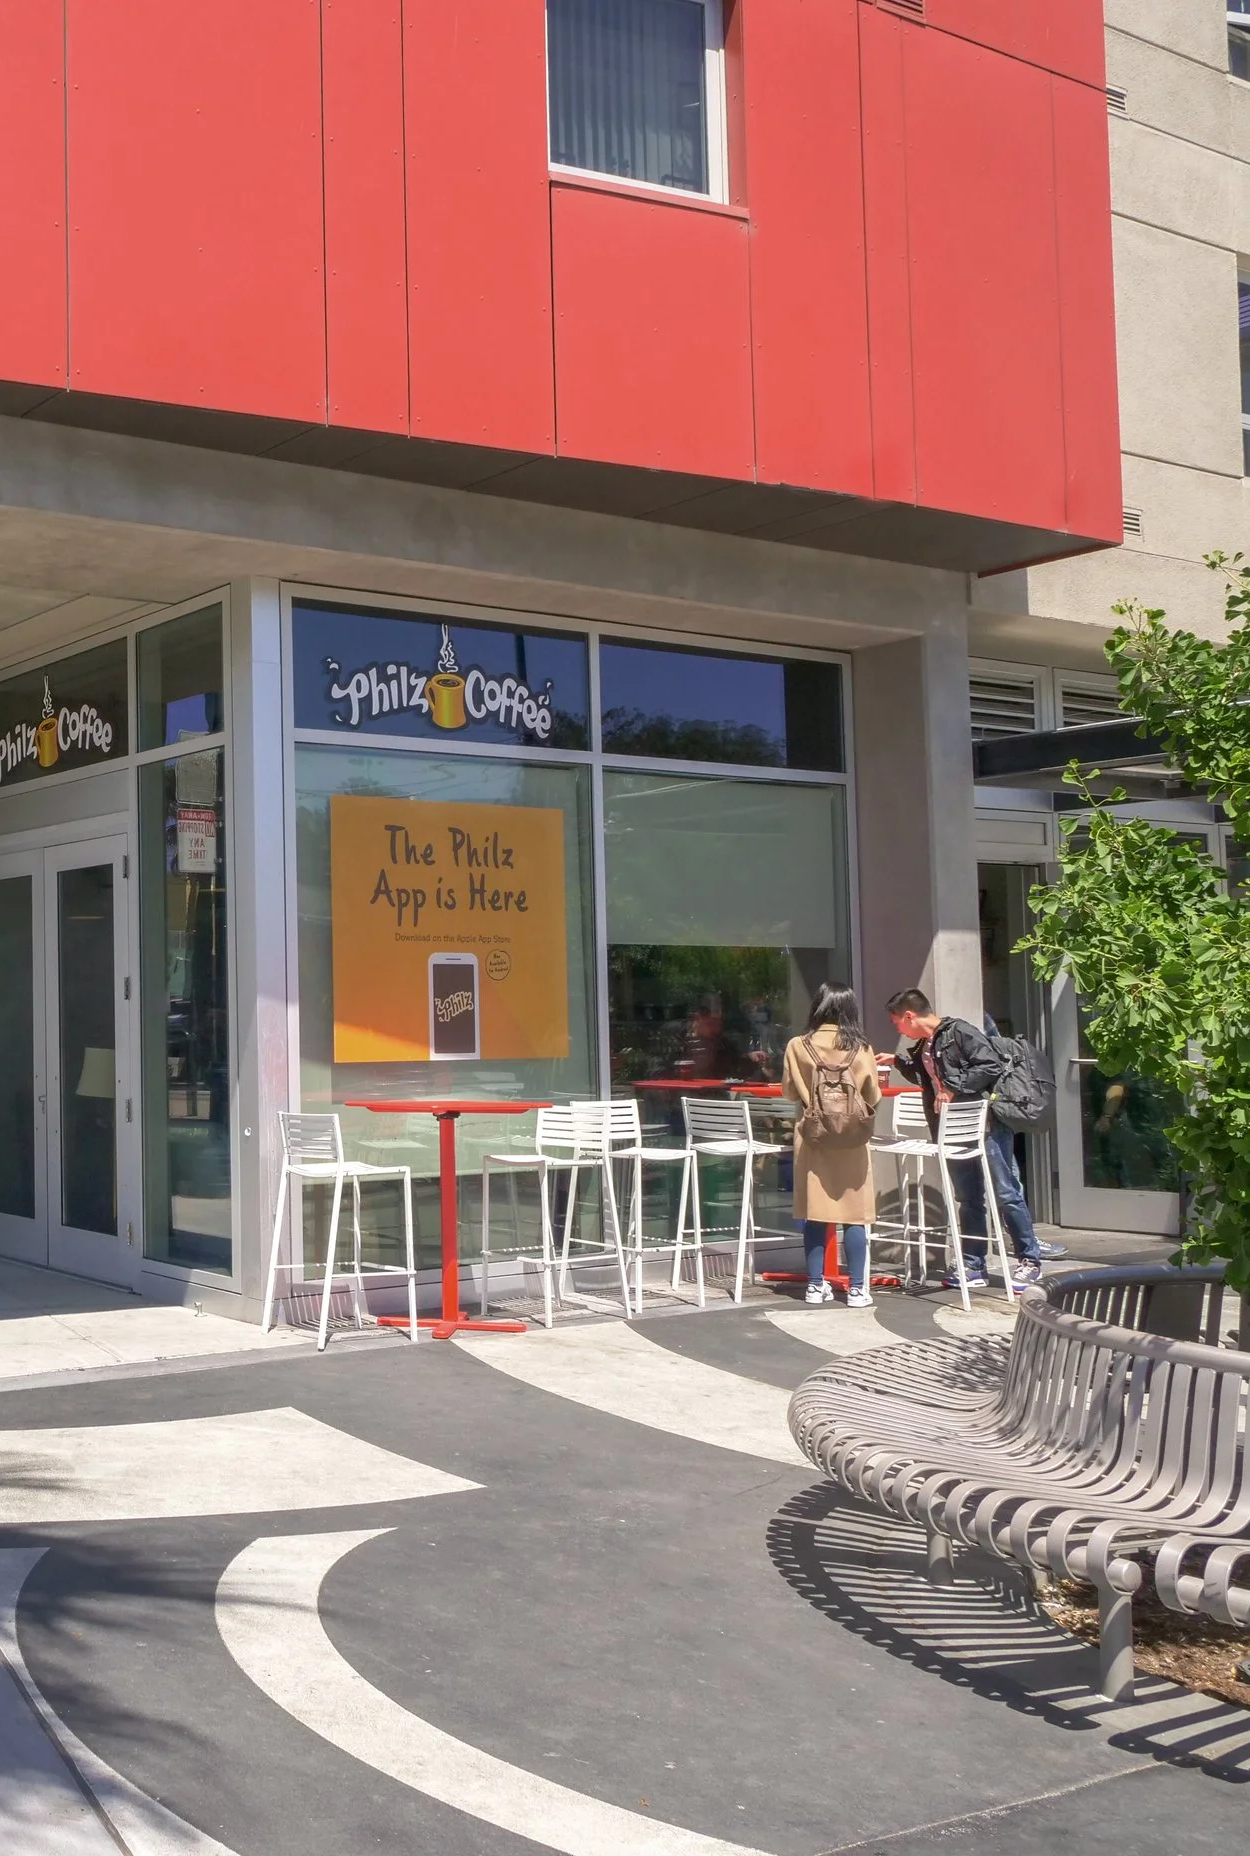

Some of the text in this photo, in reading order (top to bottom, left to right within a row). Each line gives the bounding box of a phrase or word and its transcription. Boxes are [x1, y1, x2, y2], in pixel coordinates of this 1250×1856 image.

[464, 669, 551, 739] Coffee
[58, 704, 113, 753] Coffee
[384, 824, 514, 869] The Philz
[370, 868, 529, 927] App is Here
[395, 932, 431, 942] Download
[443, 933, 455, 942] the
[456, 934, 477, 944] Apple
[478, 934, 492, 944] App
[493, 934, 511, 943] Store
[435, 990, 475, 1022] Philz
